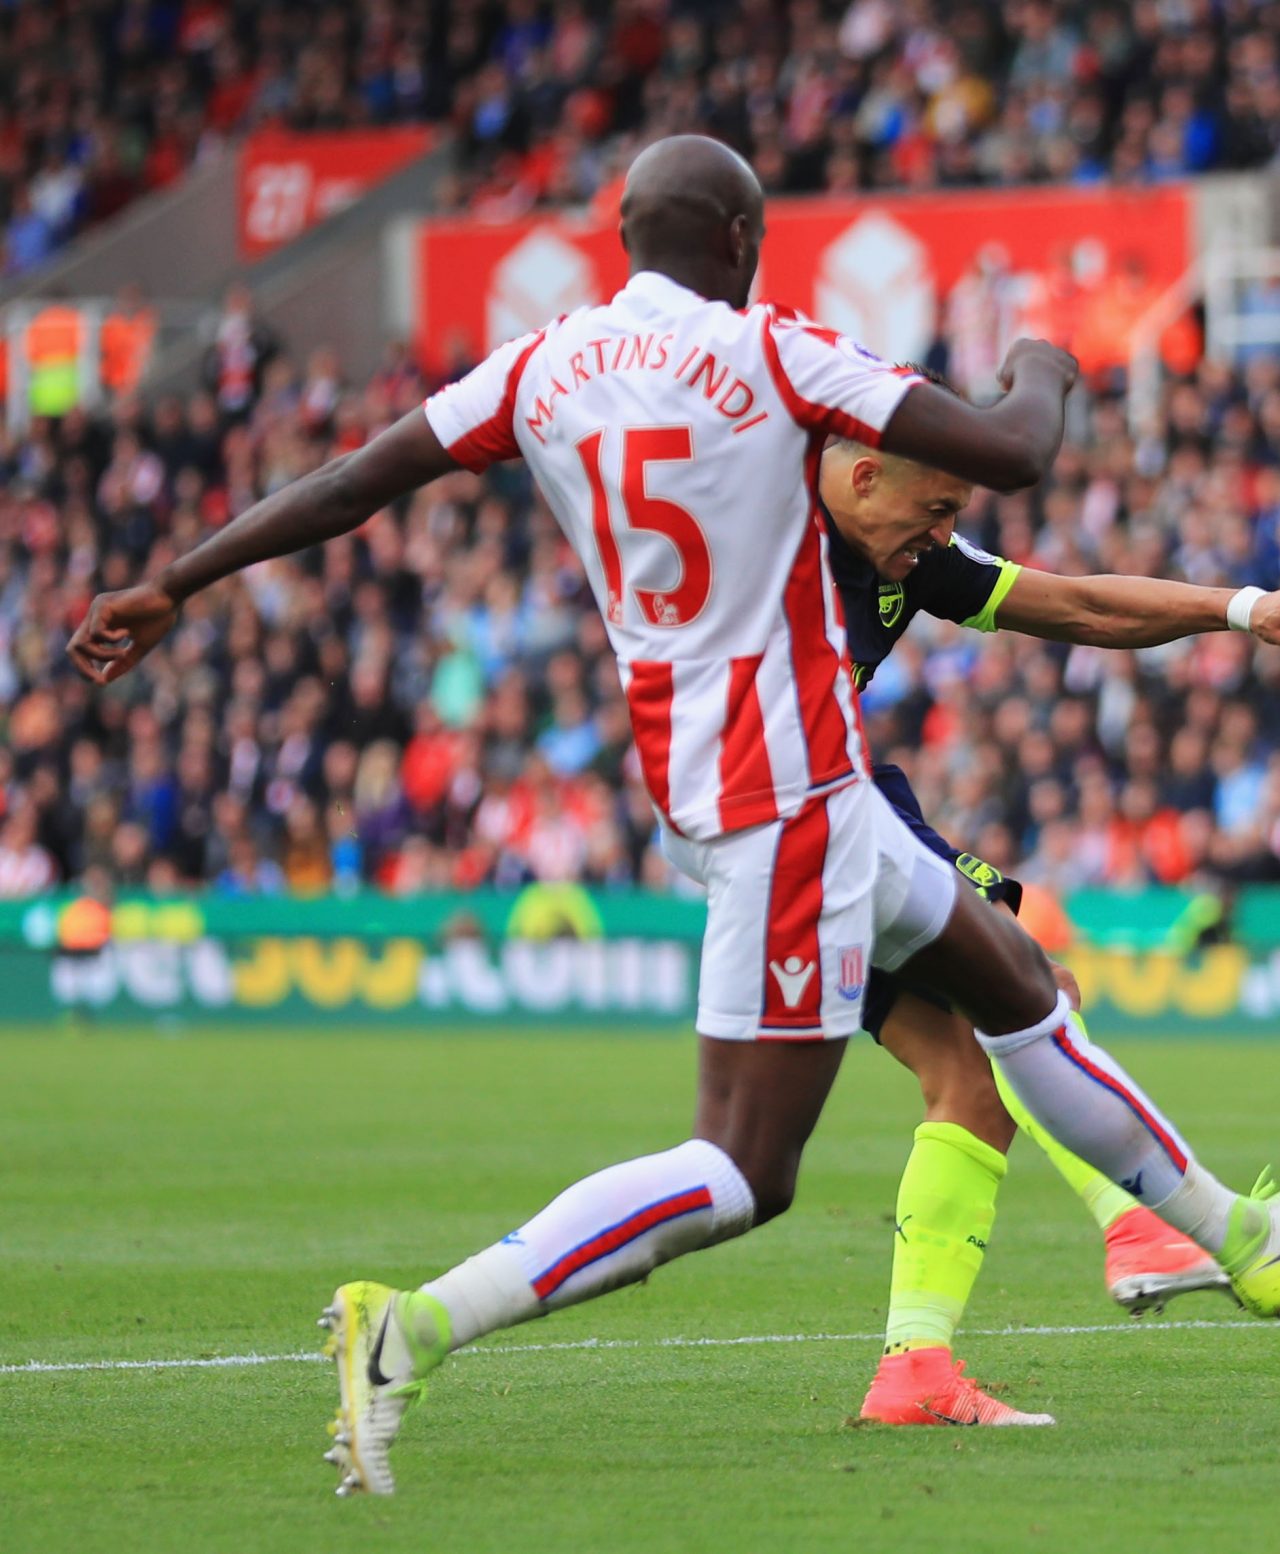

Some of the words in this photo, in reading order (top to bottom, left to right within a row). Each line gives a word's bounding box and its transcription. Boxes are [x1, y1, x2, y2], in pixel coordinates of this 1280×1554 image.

[526, 333, 673, 444] MARTINS
[674, 346, 768, 434] INDI
[573, 424, 713, 629] 15
